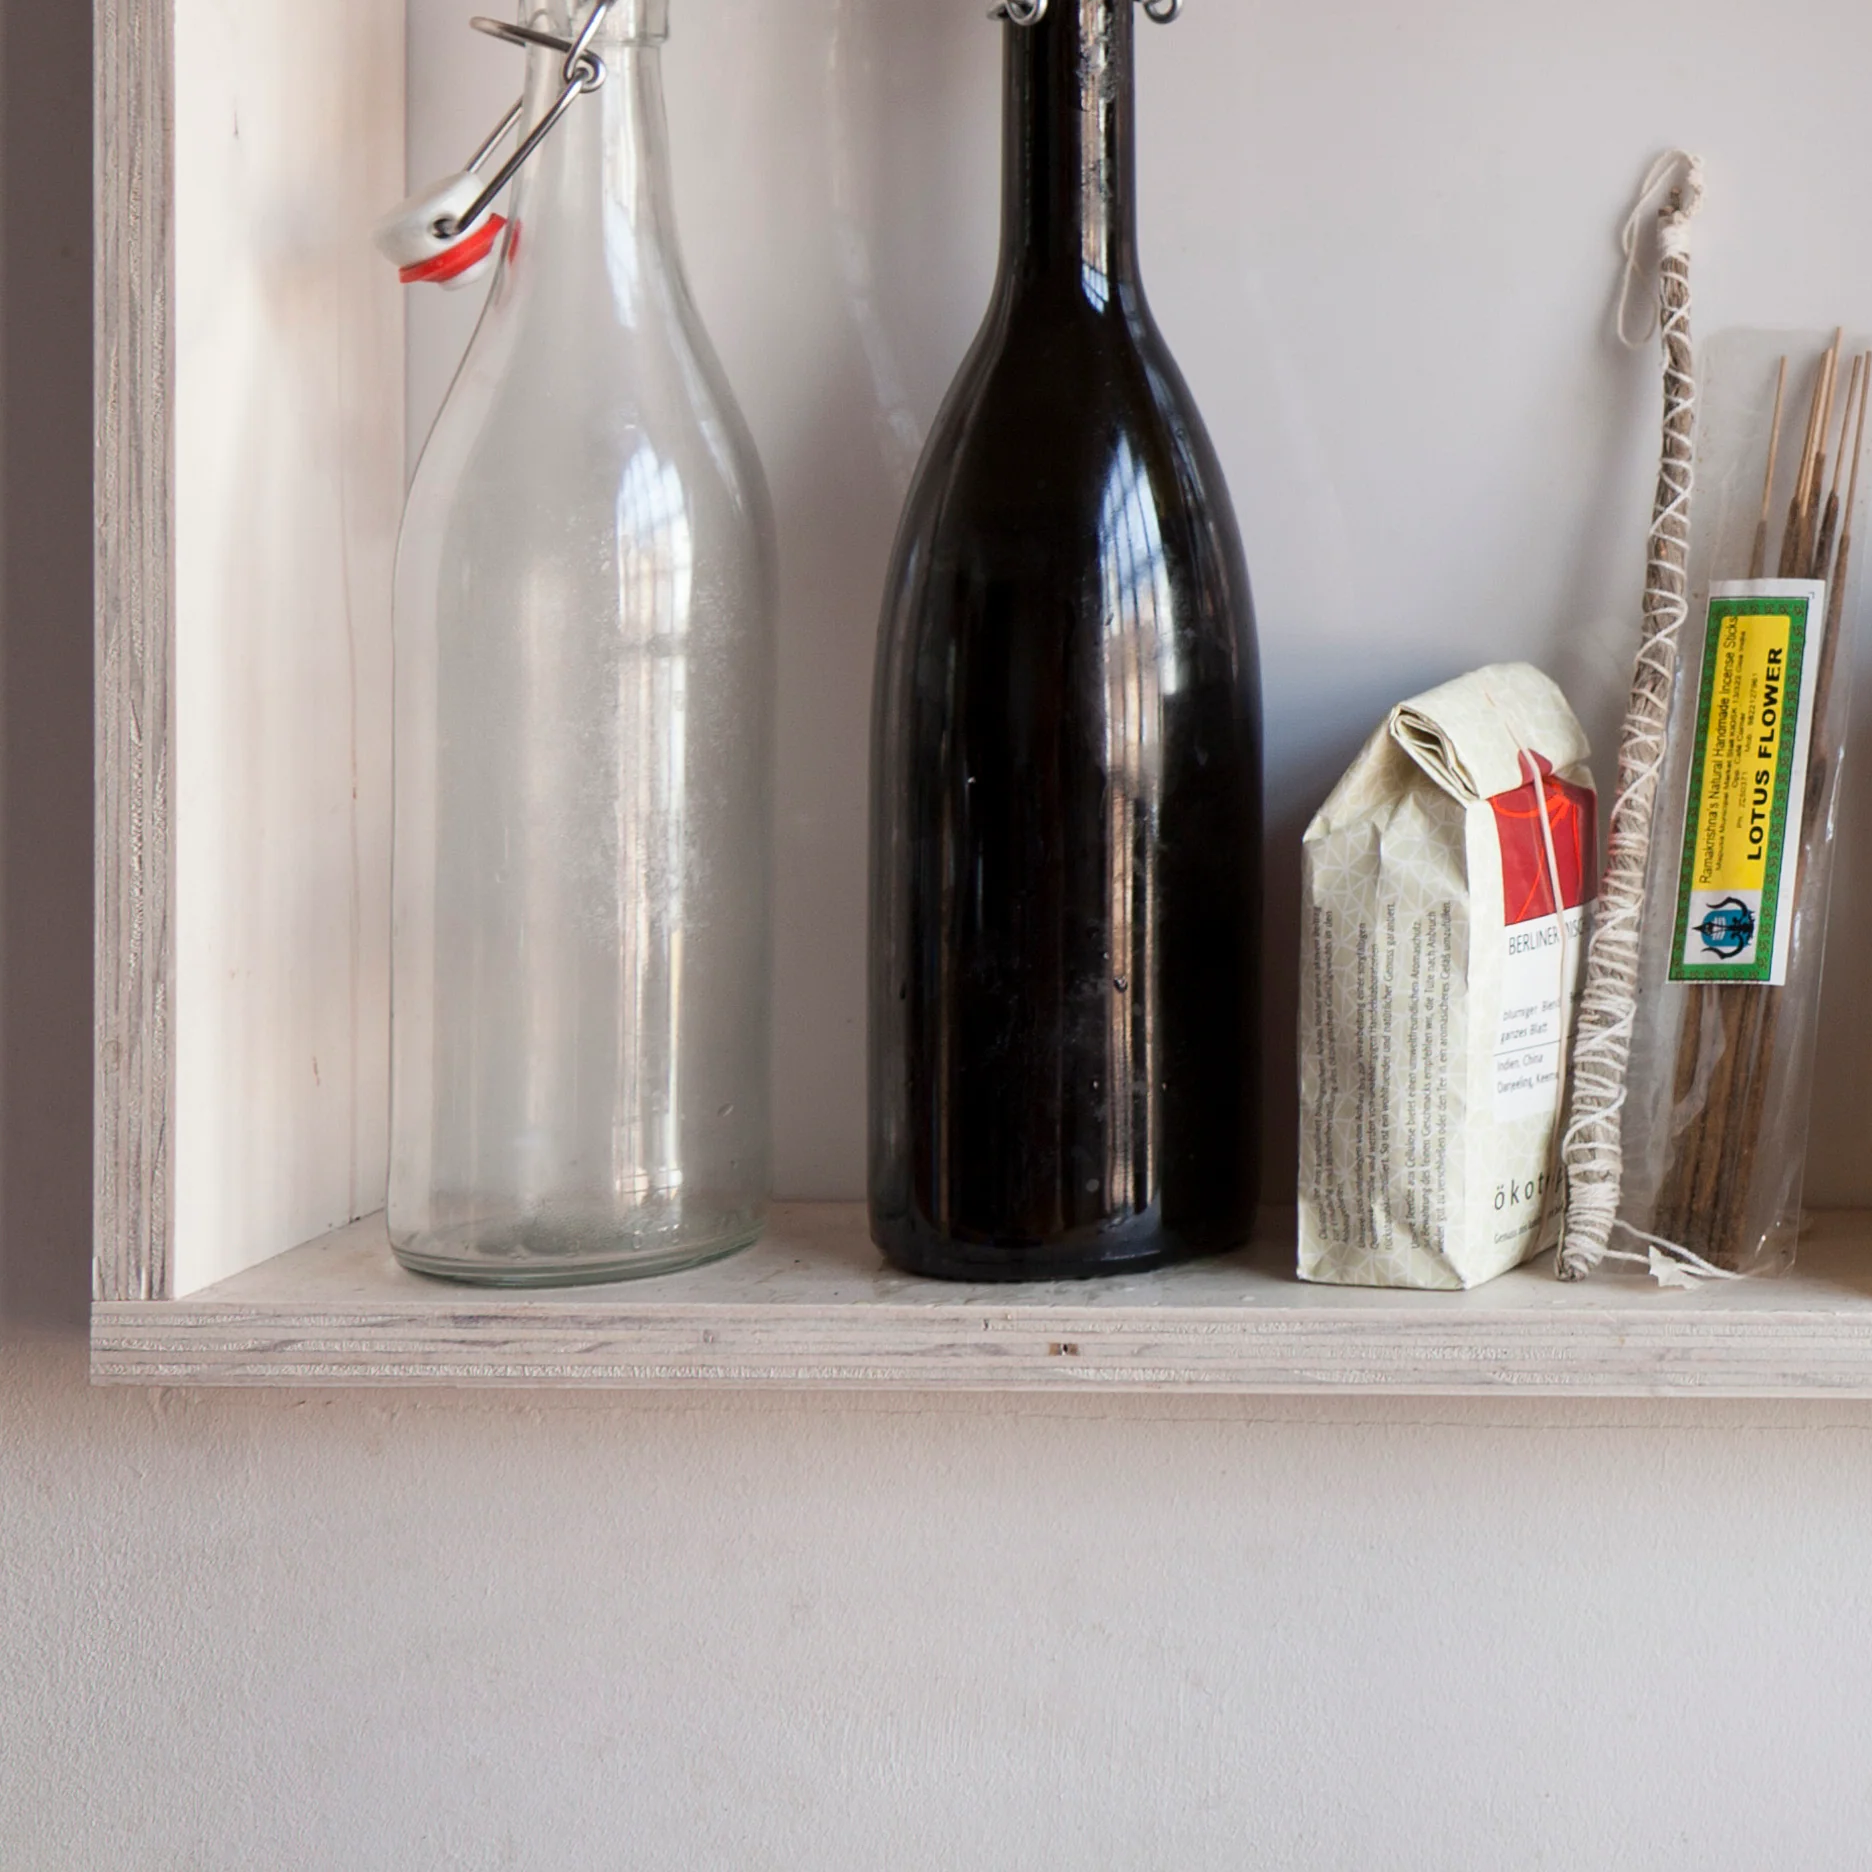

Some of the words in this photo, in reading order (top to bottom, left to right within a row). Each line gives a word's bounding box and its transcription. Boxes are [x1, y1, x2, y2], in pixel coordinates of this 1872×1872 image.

[1723, 614, 1738, 647] Sticks
[1718, 650, 1735, 694] Incense
[1758, 646, 1782, 758] FLOWER
[1713, 696, 1730, 756] Handmade
[1736, 711, 1746, 741] Corner
[1708, 759, 1723, 798] Natural
[1724, 759, 1733, 788] Market
[1747, 768, 1770, 859] LOTUS
[1698, 801, 1718, 883] Ramakrishna's
[1425, 909, 1438, 947] Anbruch
[1508, 924, 1561, 957] BERLINER
[1522, 1052, 1544, 1066] China
[1420, 1081, 1432, 1135] Geschmacks
[1405, 1126, 1417, 1167] Cellulose
